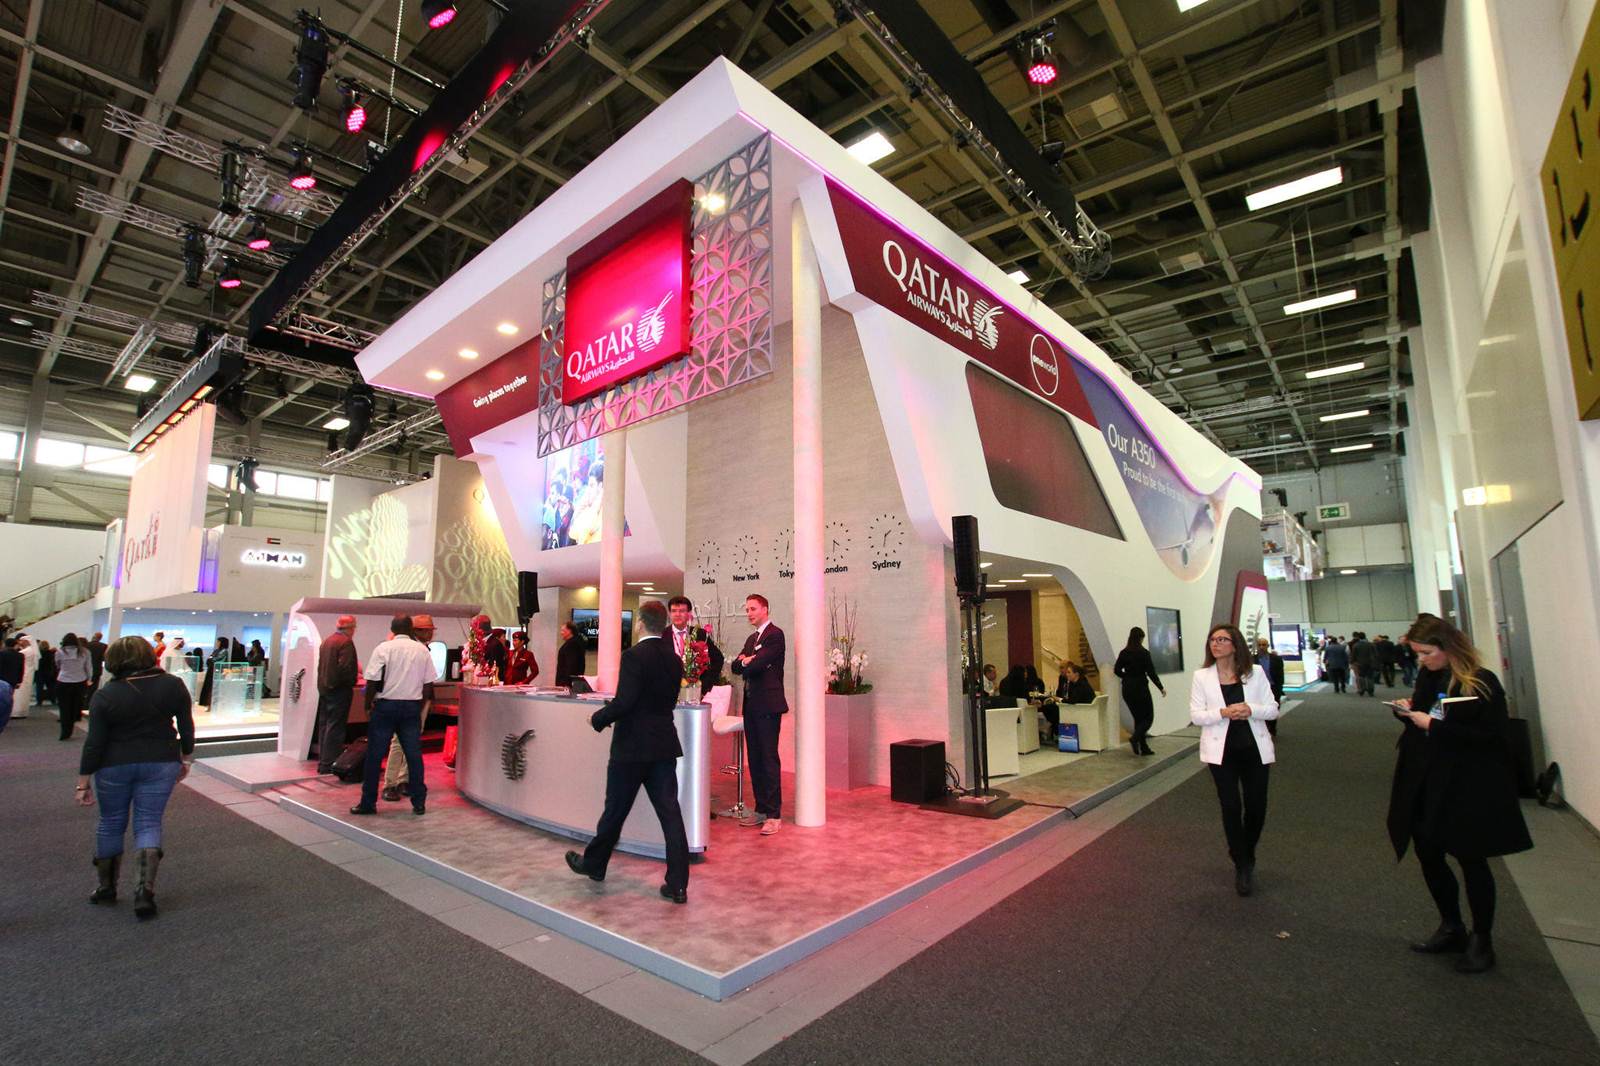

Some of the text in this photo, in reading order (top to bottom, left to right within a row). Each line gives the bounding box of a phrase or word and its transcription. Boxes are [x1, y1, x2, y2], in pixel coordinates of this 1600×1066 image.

[882, 240, 971, 325] QATAR
[907, 291, 946, 324] AIRWAYS
[567, 323, 634, 380] QATAR
[503, 376, 528, 392] together
[580, 365, 610, 384] AIRWAYS
[1108, 423, 1156, 469] Our A350
[1122, 461, 1142, 483] Proud
[779, 570, 795, 578] Toky
[872, 560, 901, 571] Sydney
[747, 573, 760, 581] York
